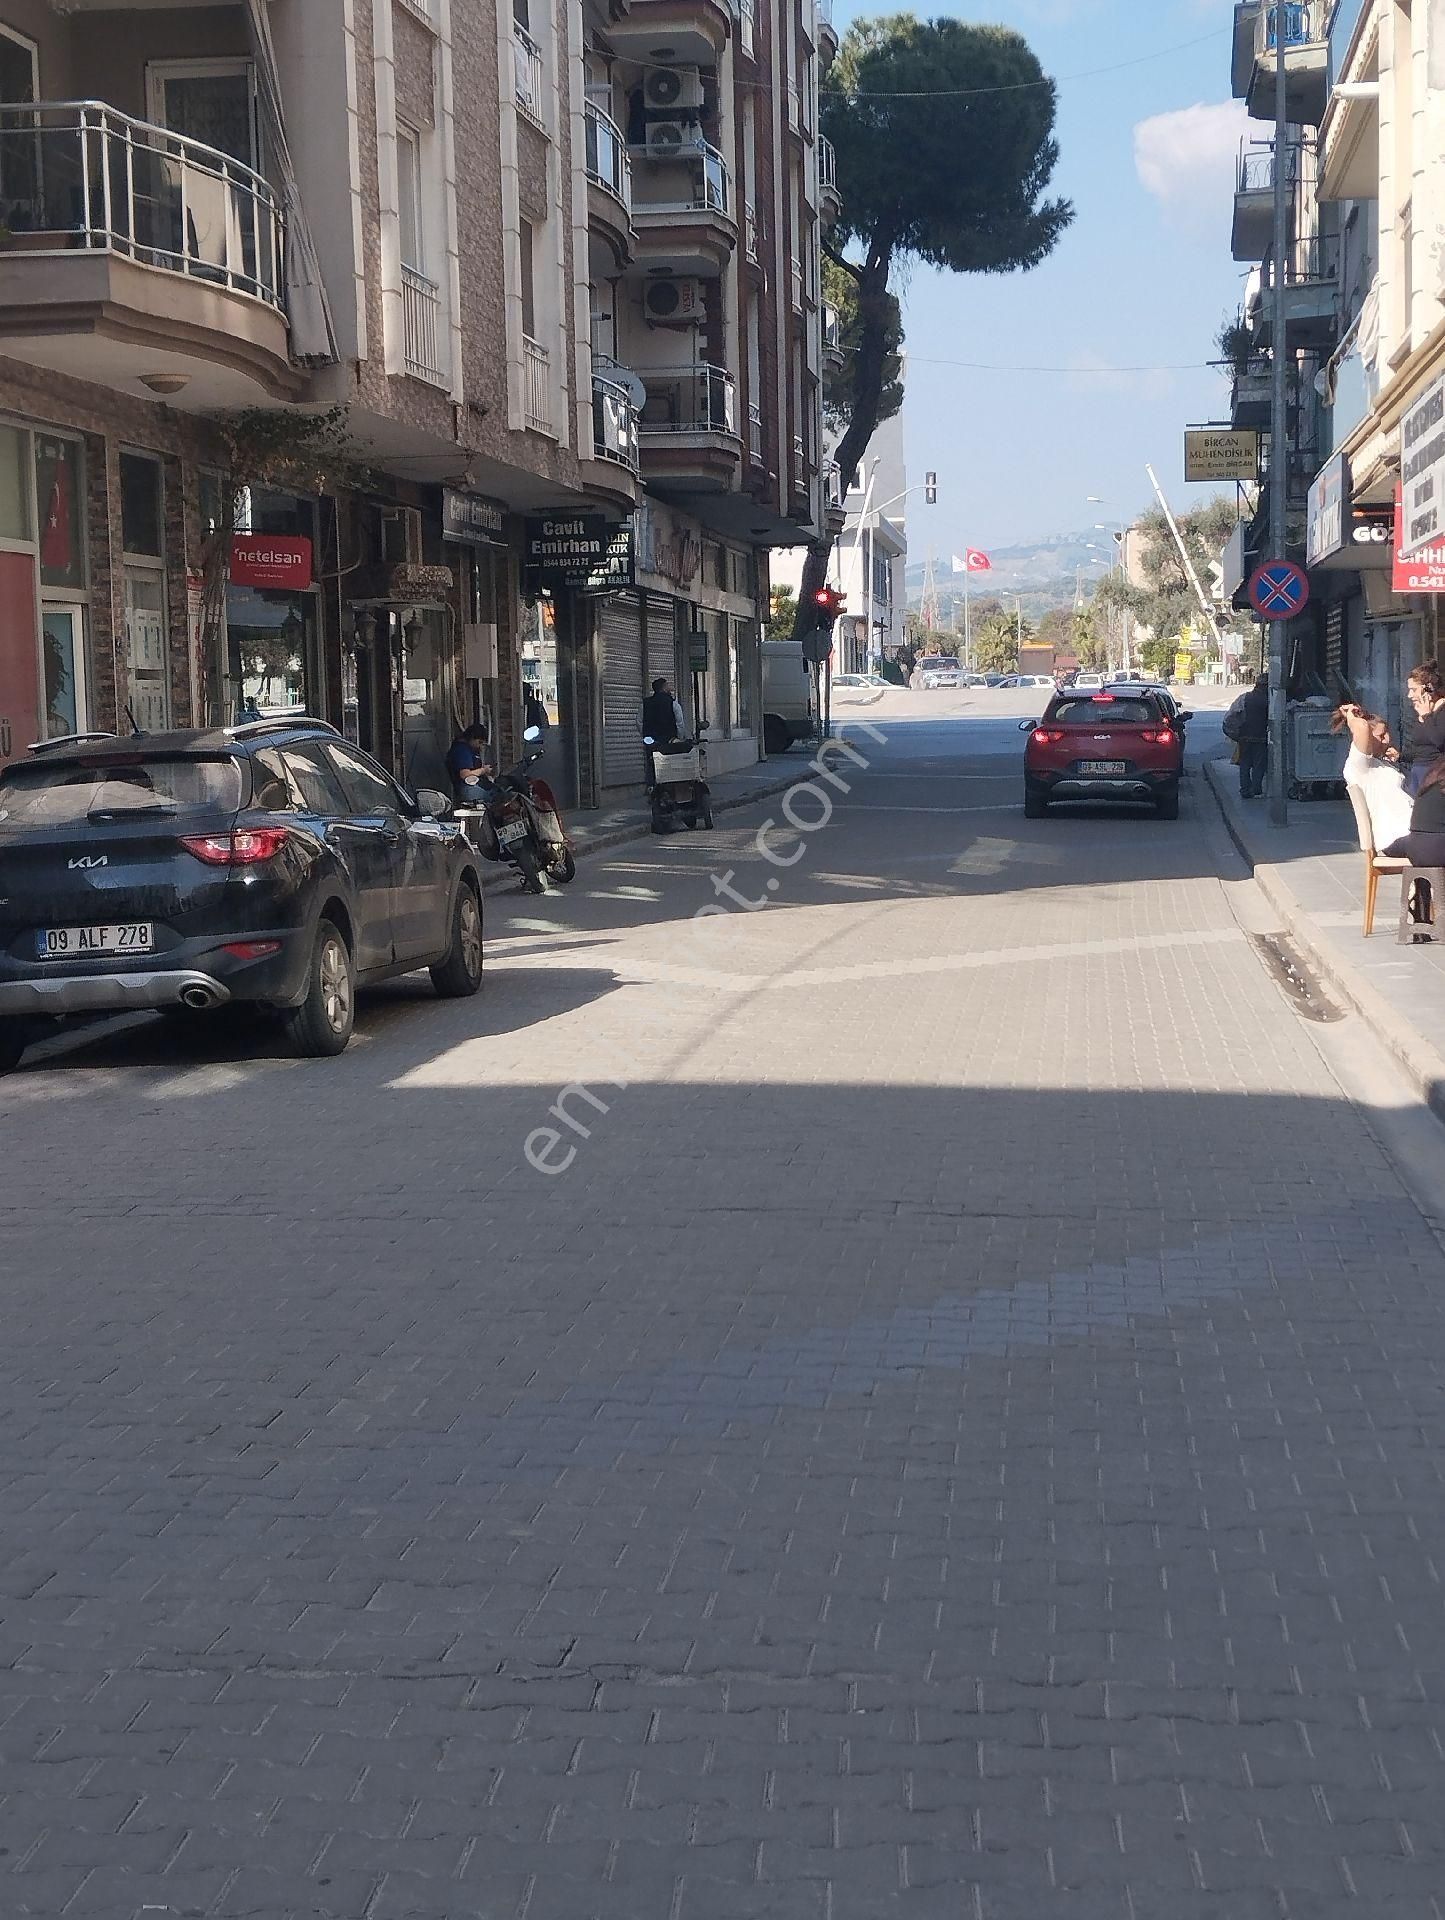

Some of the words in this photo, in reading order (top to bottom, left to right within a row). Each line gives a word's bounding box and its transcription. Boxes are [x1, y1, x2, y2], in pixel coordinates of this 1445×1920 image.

[542, 520, 585, 536] Cavit
[531, 539, 601, 555] Emirhan
[238, 550, 302, 565] netelsan
[68, 855, 108, 869] KIA
[48, 930, 68, 951] 09
[78, 927, 109, 950] ALF
[117, 925, 149, 947] 278
